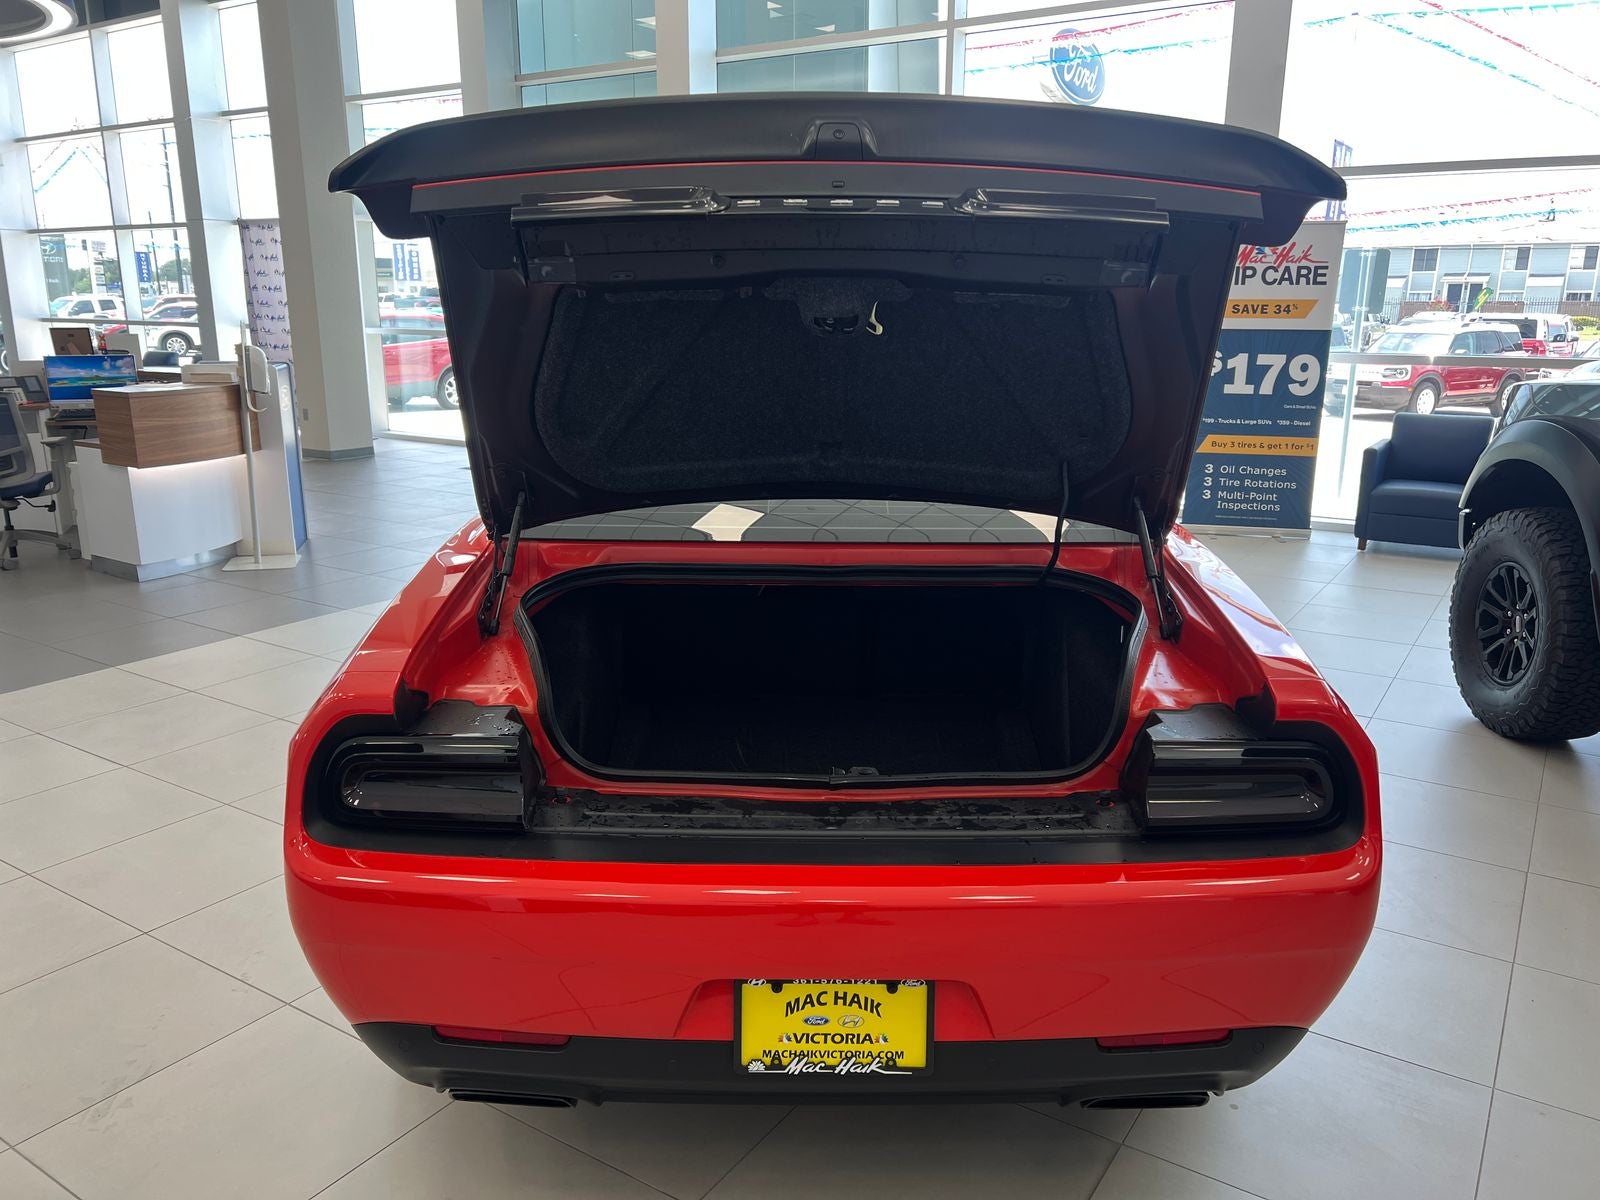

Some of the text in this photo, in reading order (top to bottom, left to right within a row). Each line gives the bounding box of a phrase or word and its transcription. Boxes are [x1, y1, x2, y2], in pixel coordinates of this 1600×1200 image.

[1063, 43, 1099, 94] Ford
[1237, 242, 1328, 269] Mac Haik
[1233, 265, 1329, 286] IP CARE
[1231, 304, 1269, 314] SAVE
[1211, 351, 1320, 396] $179
[1211, 441, 1228, 449] Buy
[1237, 441, 1257, 449] tires
[1267, 443, 1283, 451] get
[1291, 442, 1305, 450] for
[1204, 463, 1287, 477] 3 Oil Changes
[1203, 476, 1297, 489] 3 Tire Rotations
[1202, 489, 1278, 501] 3 Multi-Point
[1216, 500, 1281, 511] Inspections
[784, 990, 883, 1018] MAC HAIK
[806, 1016, 826, 1025] Ford
[793, 1032, 875, 1045] VICTORIA
[761, 1049, 905, 1060] MACHAIKVICTORIACOM
[785, 1056, 902, 1075] Mac Haik
